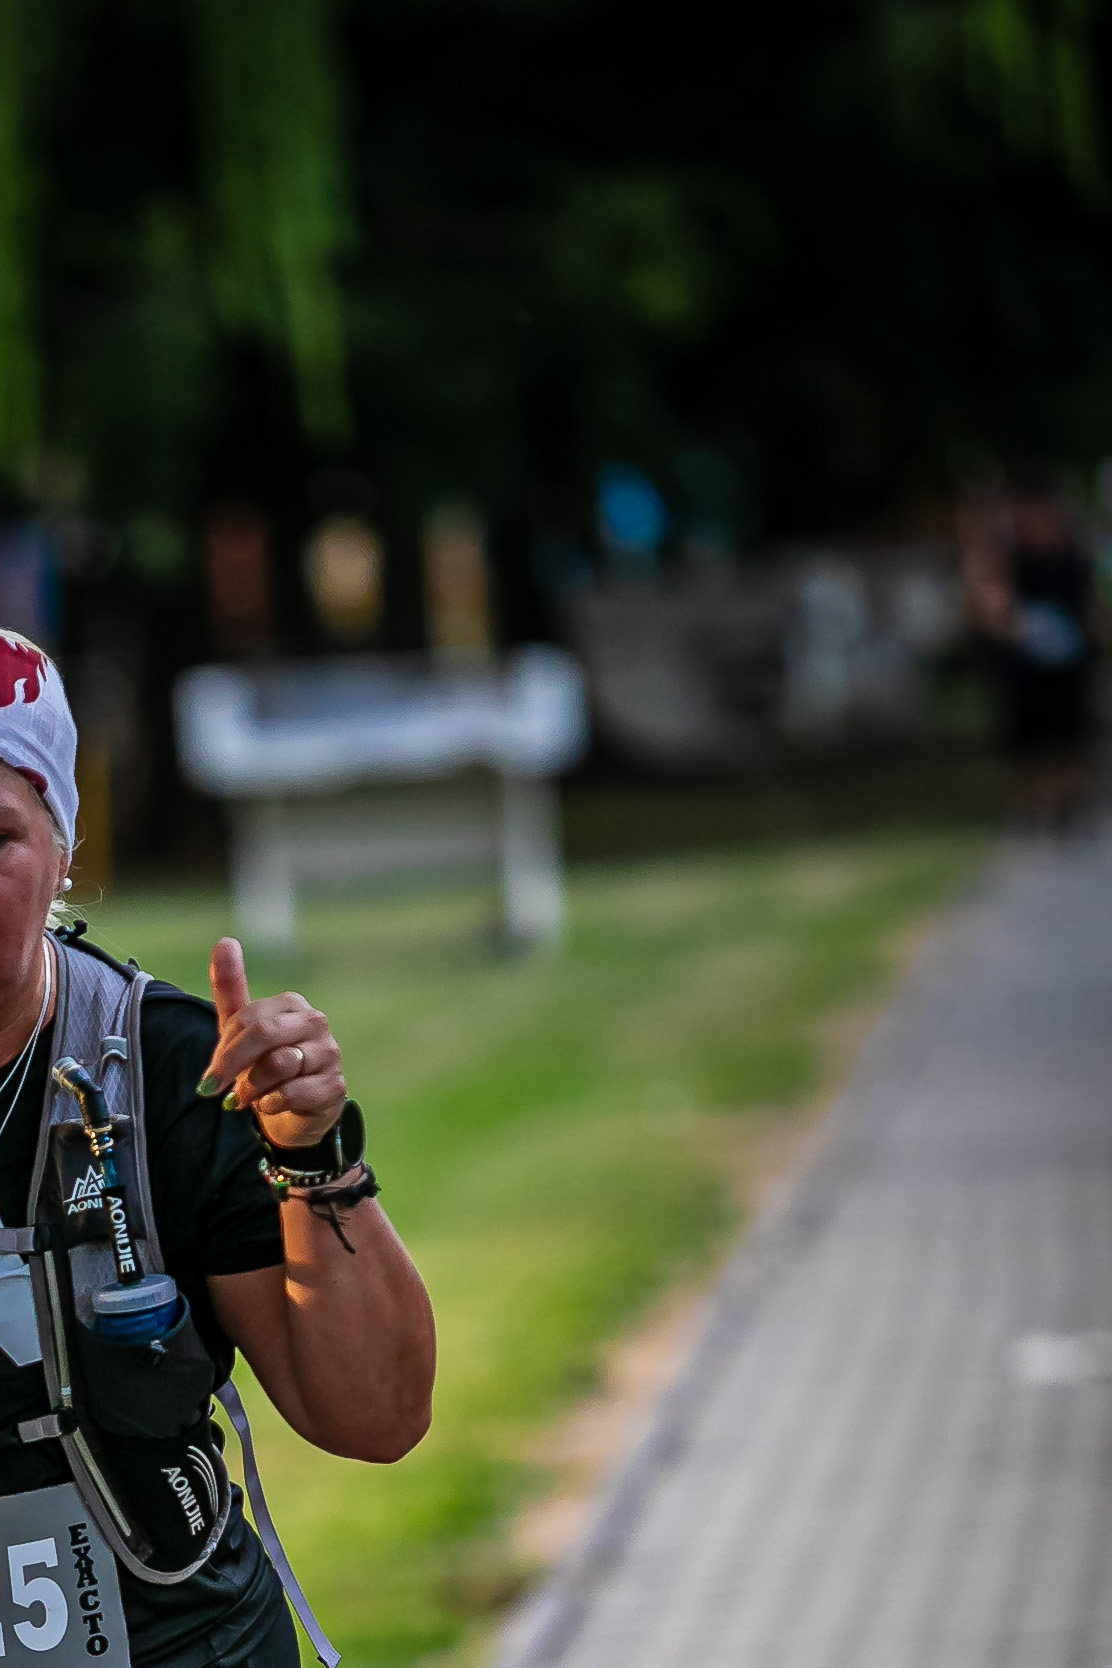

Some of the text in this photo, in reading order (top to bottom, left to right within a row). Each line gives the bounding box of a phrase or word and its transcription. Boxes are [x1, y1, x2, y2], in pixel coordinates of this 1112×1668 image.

[67, 1197, 104, 1216] AONI
[106, 1195, 136, 1274] AONIJIE
[160, 1466, 205, 1536] AONIJIE
[68, 1522, 110, 1657] EXACTO
